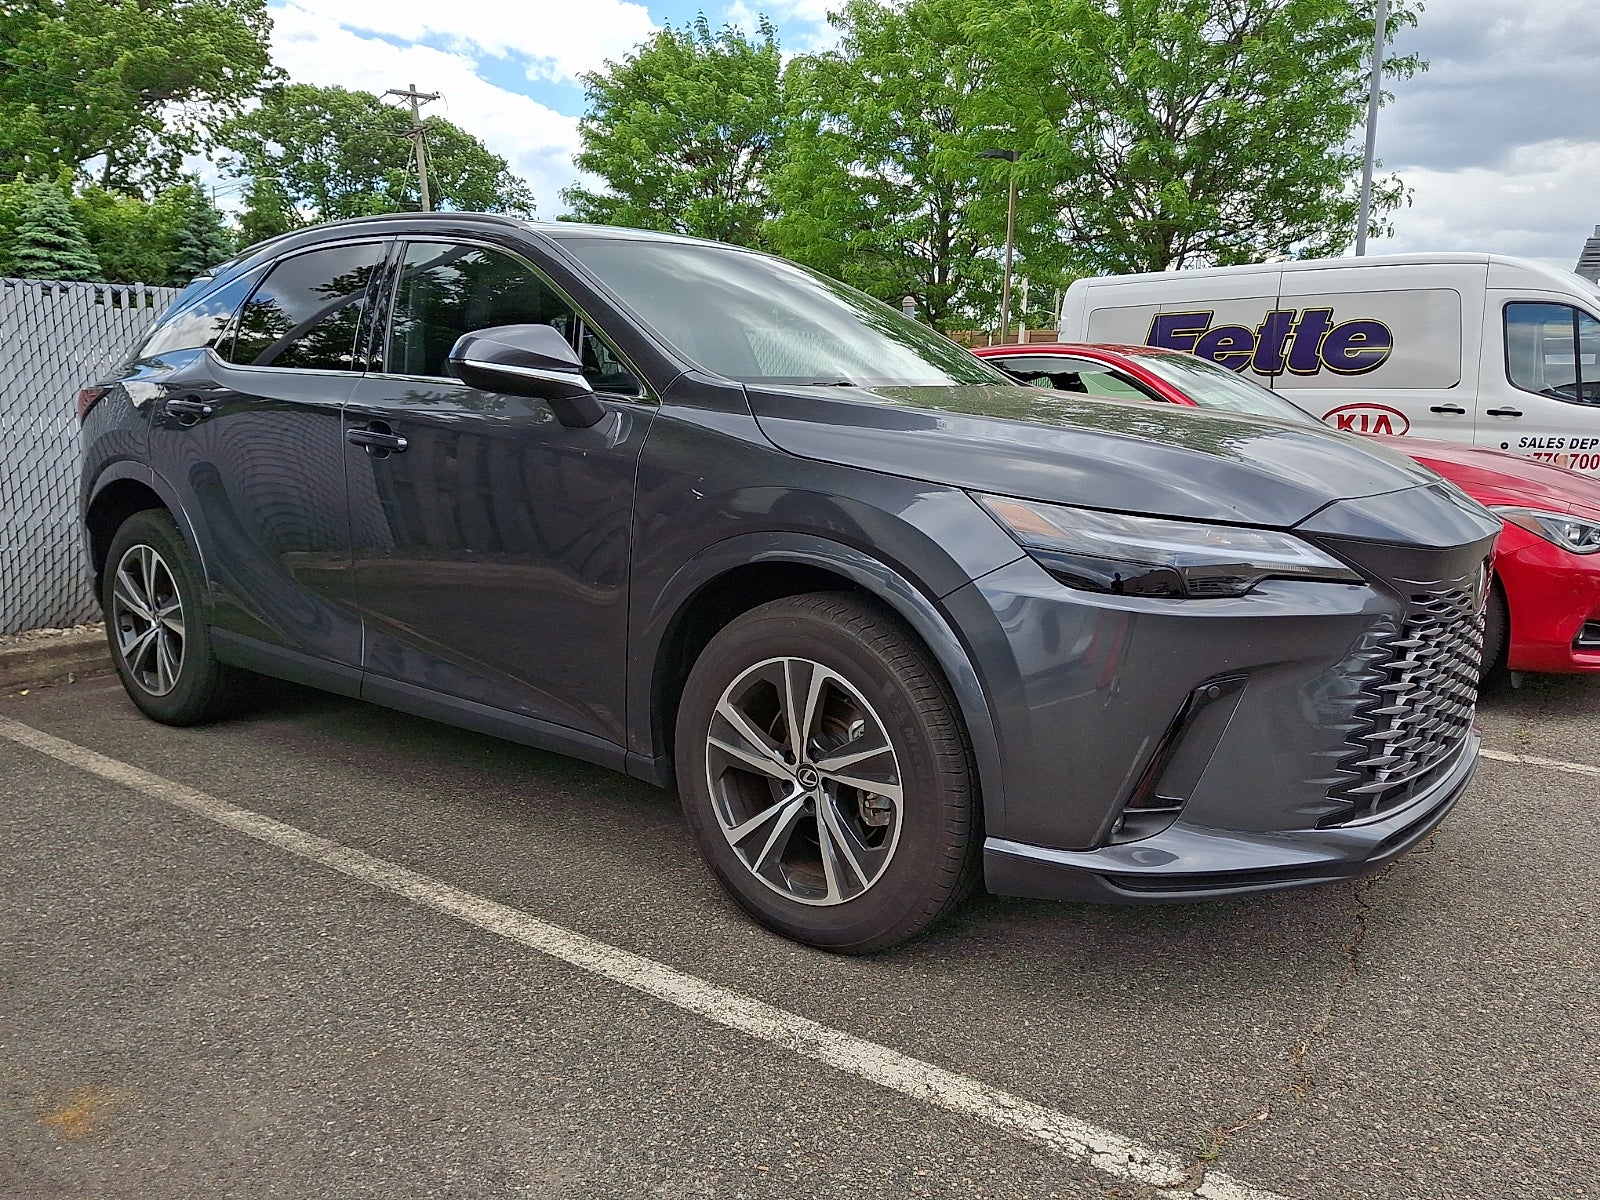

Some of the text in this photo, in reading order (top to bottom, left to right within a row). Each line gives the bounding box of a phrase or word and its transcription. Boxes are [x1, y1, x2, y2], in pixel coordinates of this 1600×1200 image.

[1143, 307, 1394, 376] Fette
[1336, 413, 1394, 435] KIA
[1518, 436, 1600, 450] SALES DEP
